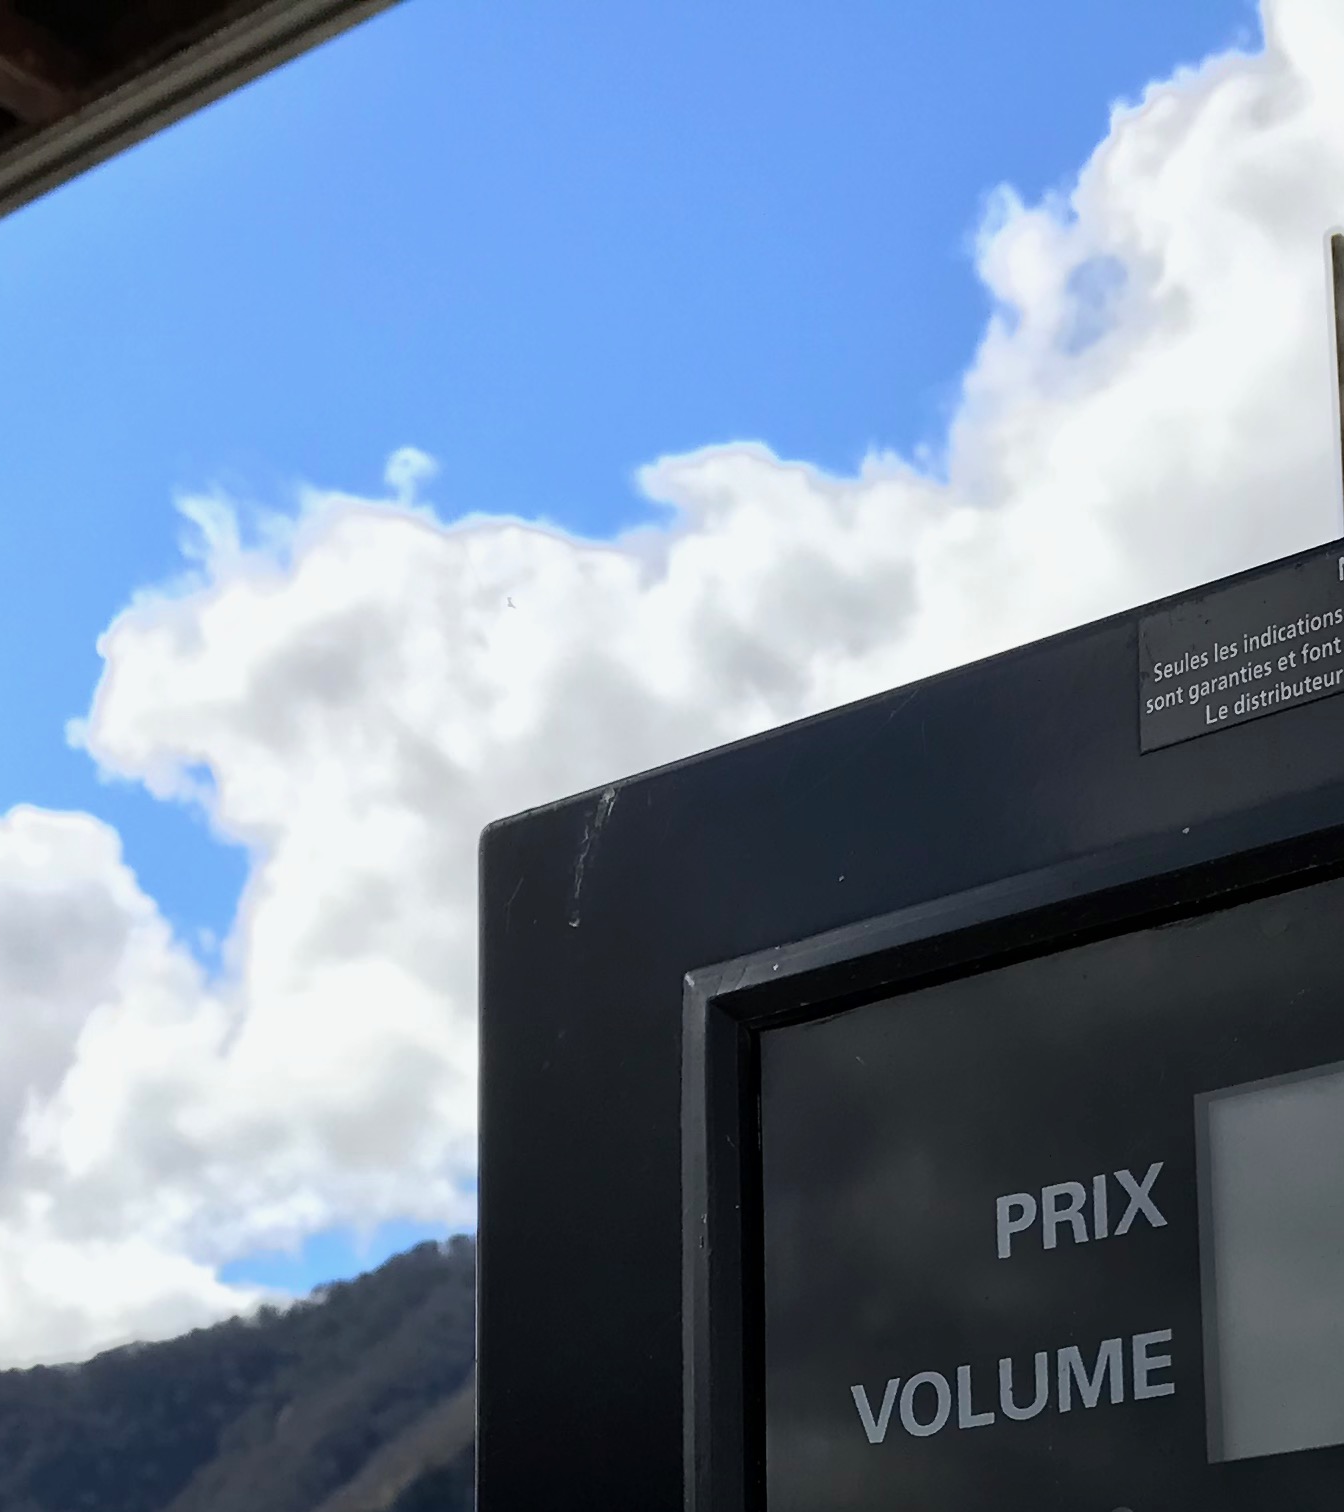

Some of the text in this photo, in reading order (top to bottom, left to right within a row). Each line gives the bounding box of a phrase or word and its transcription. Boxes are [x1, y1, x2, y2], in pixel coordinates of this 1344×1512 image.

[1146, 687, 1183, 714] sont
[1188, 662, 1272, 705] garanties
[1277, 652, 1296, 671] et
[1301, 637, 1341, 665] font
[1154, 652, 1208, 683] Seules
[1214, 643, 1238, 662] les
[1244, 608, 1343, 653] indications
[1206, 702, 1228, 724] Le
[1234, 666, 1343, 715] distributeur
[996, 1161, 1168, 1259] PRIX
[851, 1329, 1175, 1443] VOLUME
